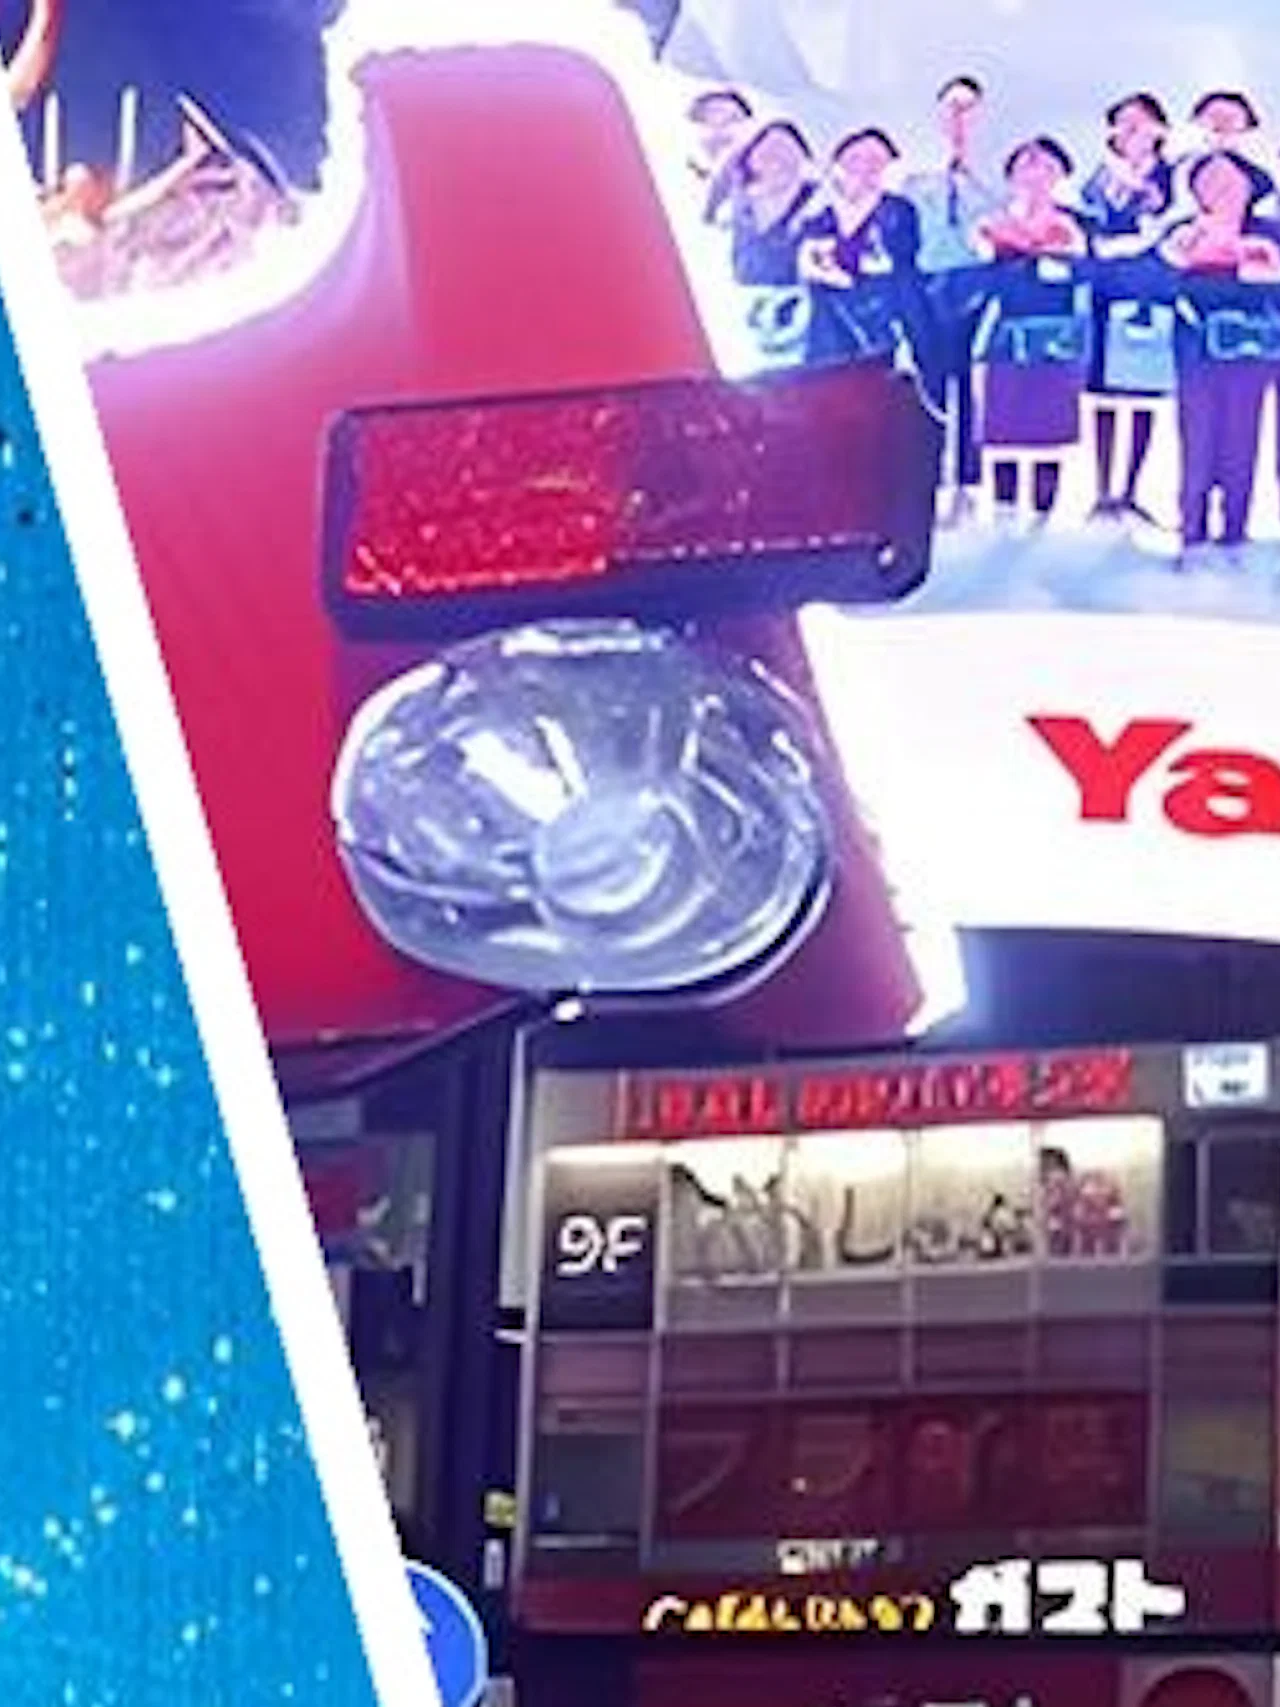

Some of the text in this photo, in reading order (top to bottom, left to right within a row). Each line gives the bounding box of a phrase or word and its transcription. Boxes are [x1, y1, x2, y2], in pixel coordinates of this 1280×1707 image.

[556, 1214, 648, 1275] 9F
[950, 1558, 1187, 1634] ガスト
